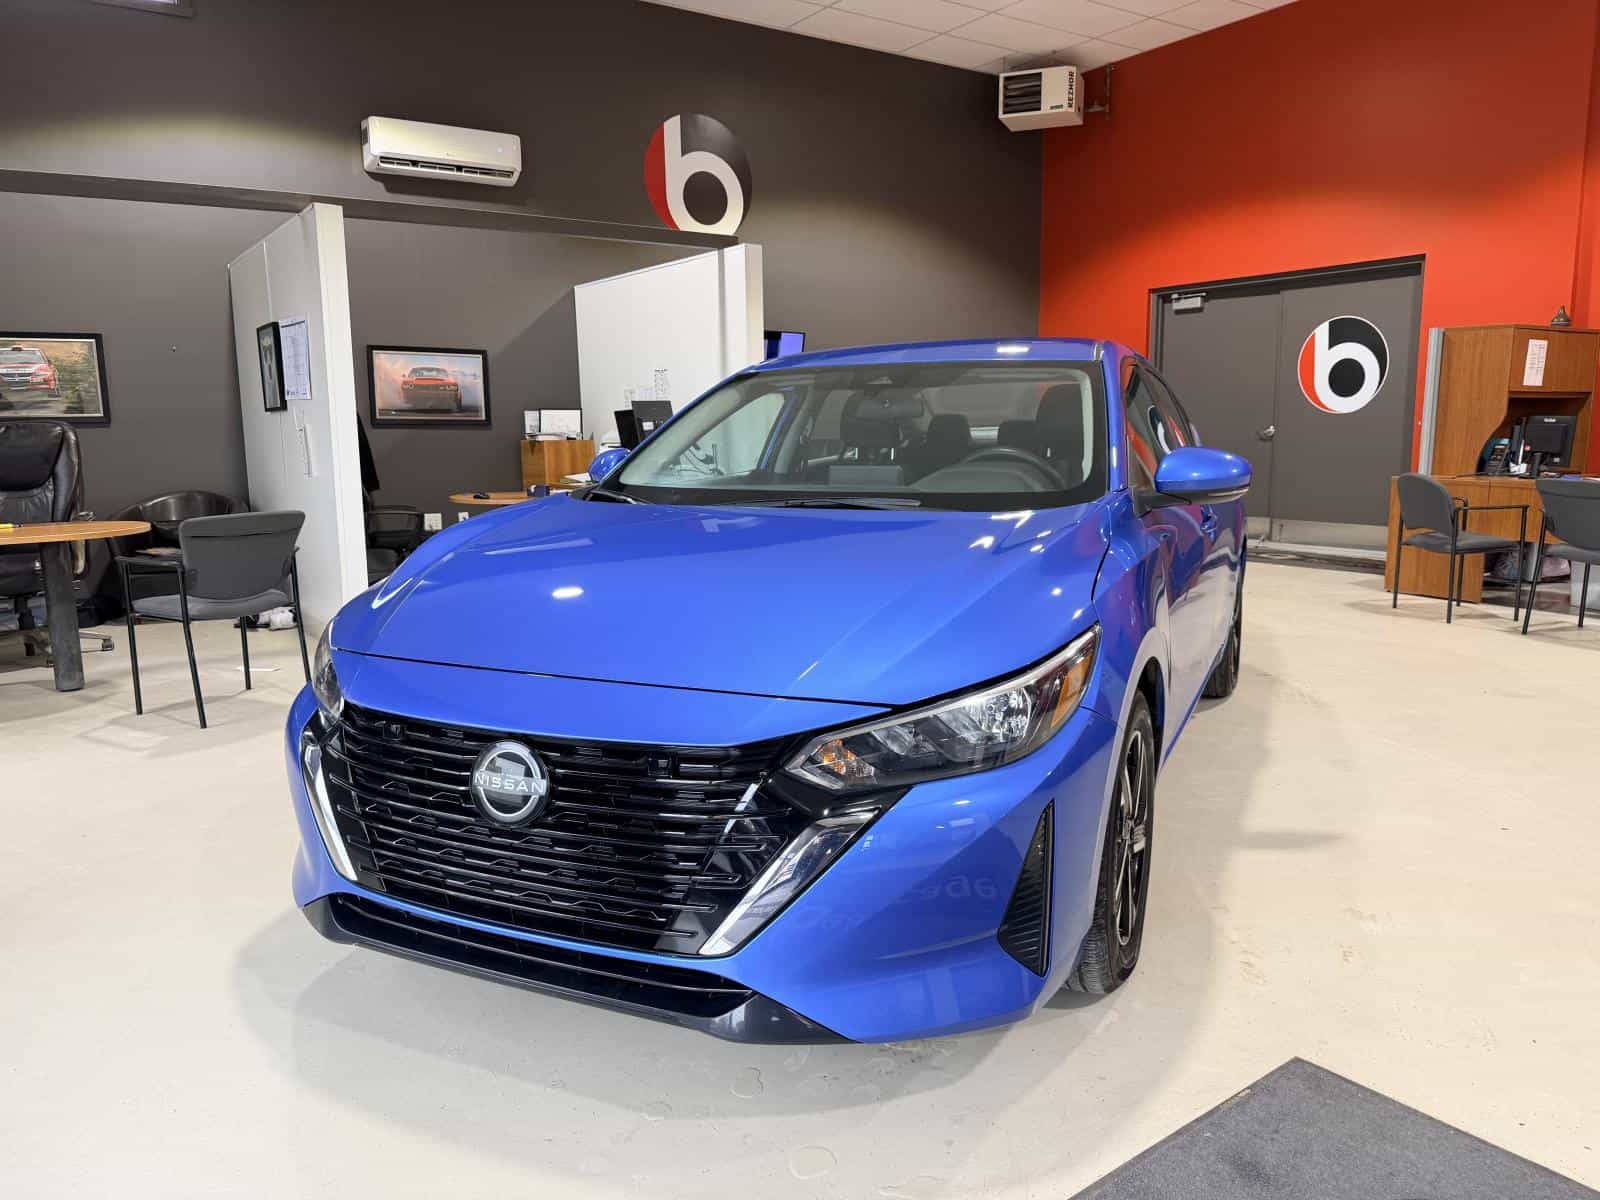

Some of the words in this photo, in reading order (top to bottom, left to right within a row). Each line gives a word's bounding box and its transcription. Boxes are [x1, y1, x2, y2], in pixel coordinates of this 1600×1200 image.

[663, 114, 744, 235] b
[1313, 318, 1381, 413] b
[474, 772, 544, 793] NISSAN
